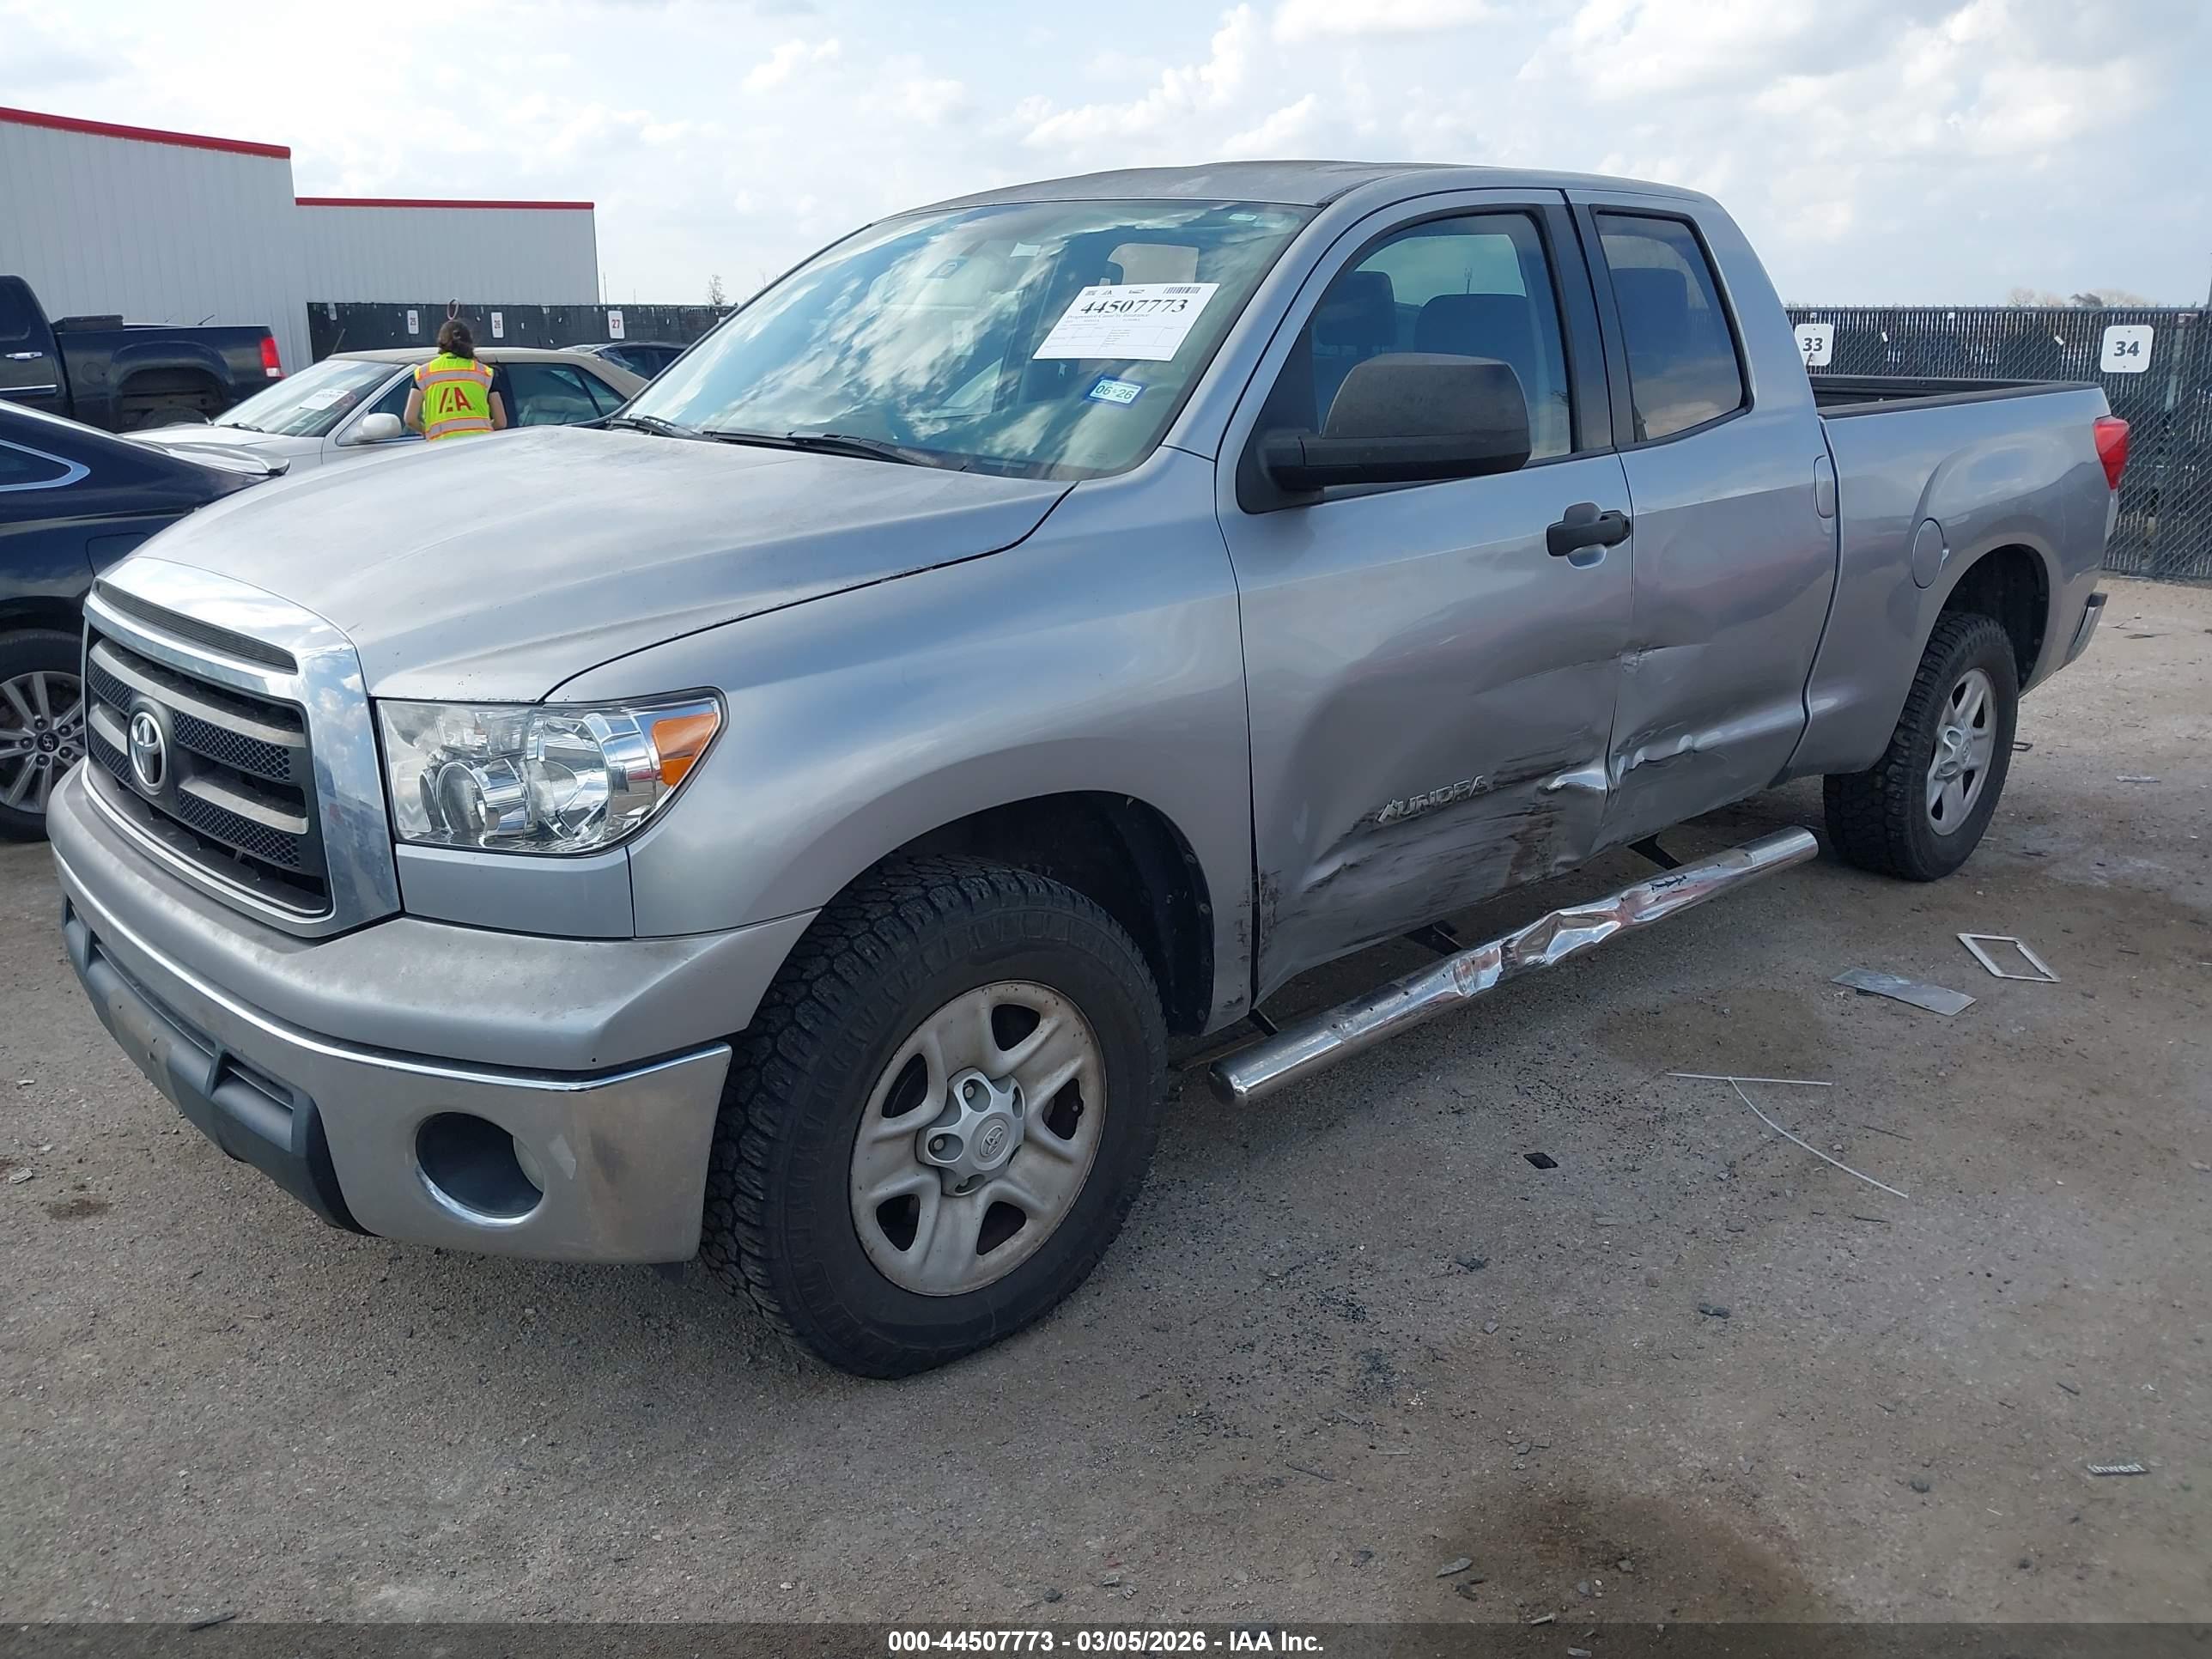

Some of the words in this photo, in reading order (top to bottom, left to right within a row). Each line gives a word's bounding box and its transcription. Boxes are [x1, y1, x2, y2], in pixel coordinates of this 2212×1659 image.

[1080, 299, 1188, 314] 44507773
[611, 319, 620, 329] 27
[1802, 337, 1823, 352] 33
[2113, 340, 2140, 357] 34
